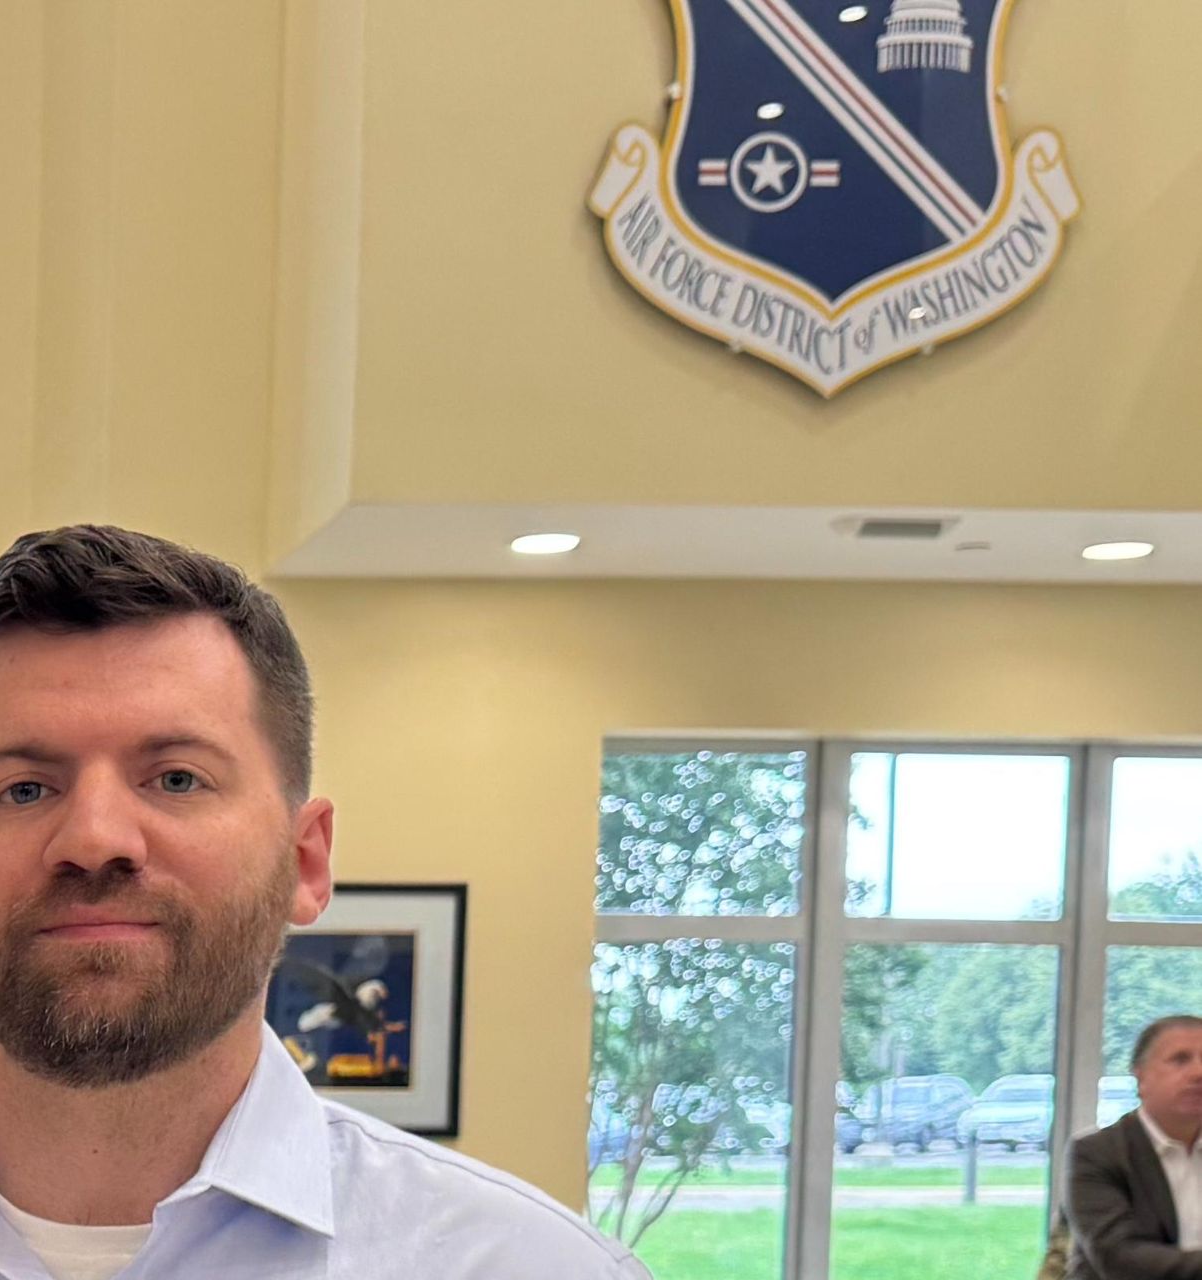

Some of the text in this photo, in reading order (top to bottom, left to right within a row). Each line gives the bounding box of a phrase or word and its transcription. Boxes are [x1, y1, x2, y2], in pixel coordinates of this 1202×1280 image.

[617, 194, 1048, 375] AIR FORCE DISTRICT of WASHINGTON
